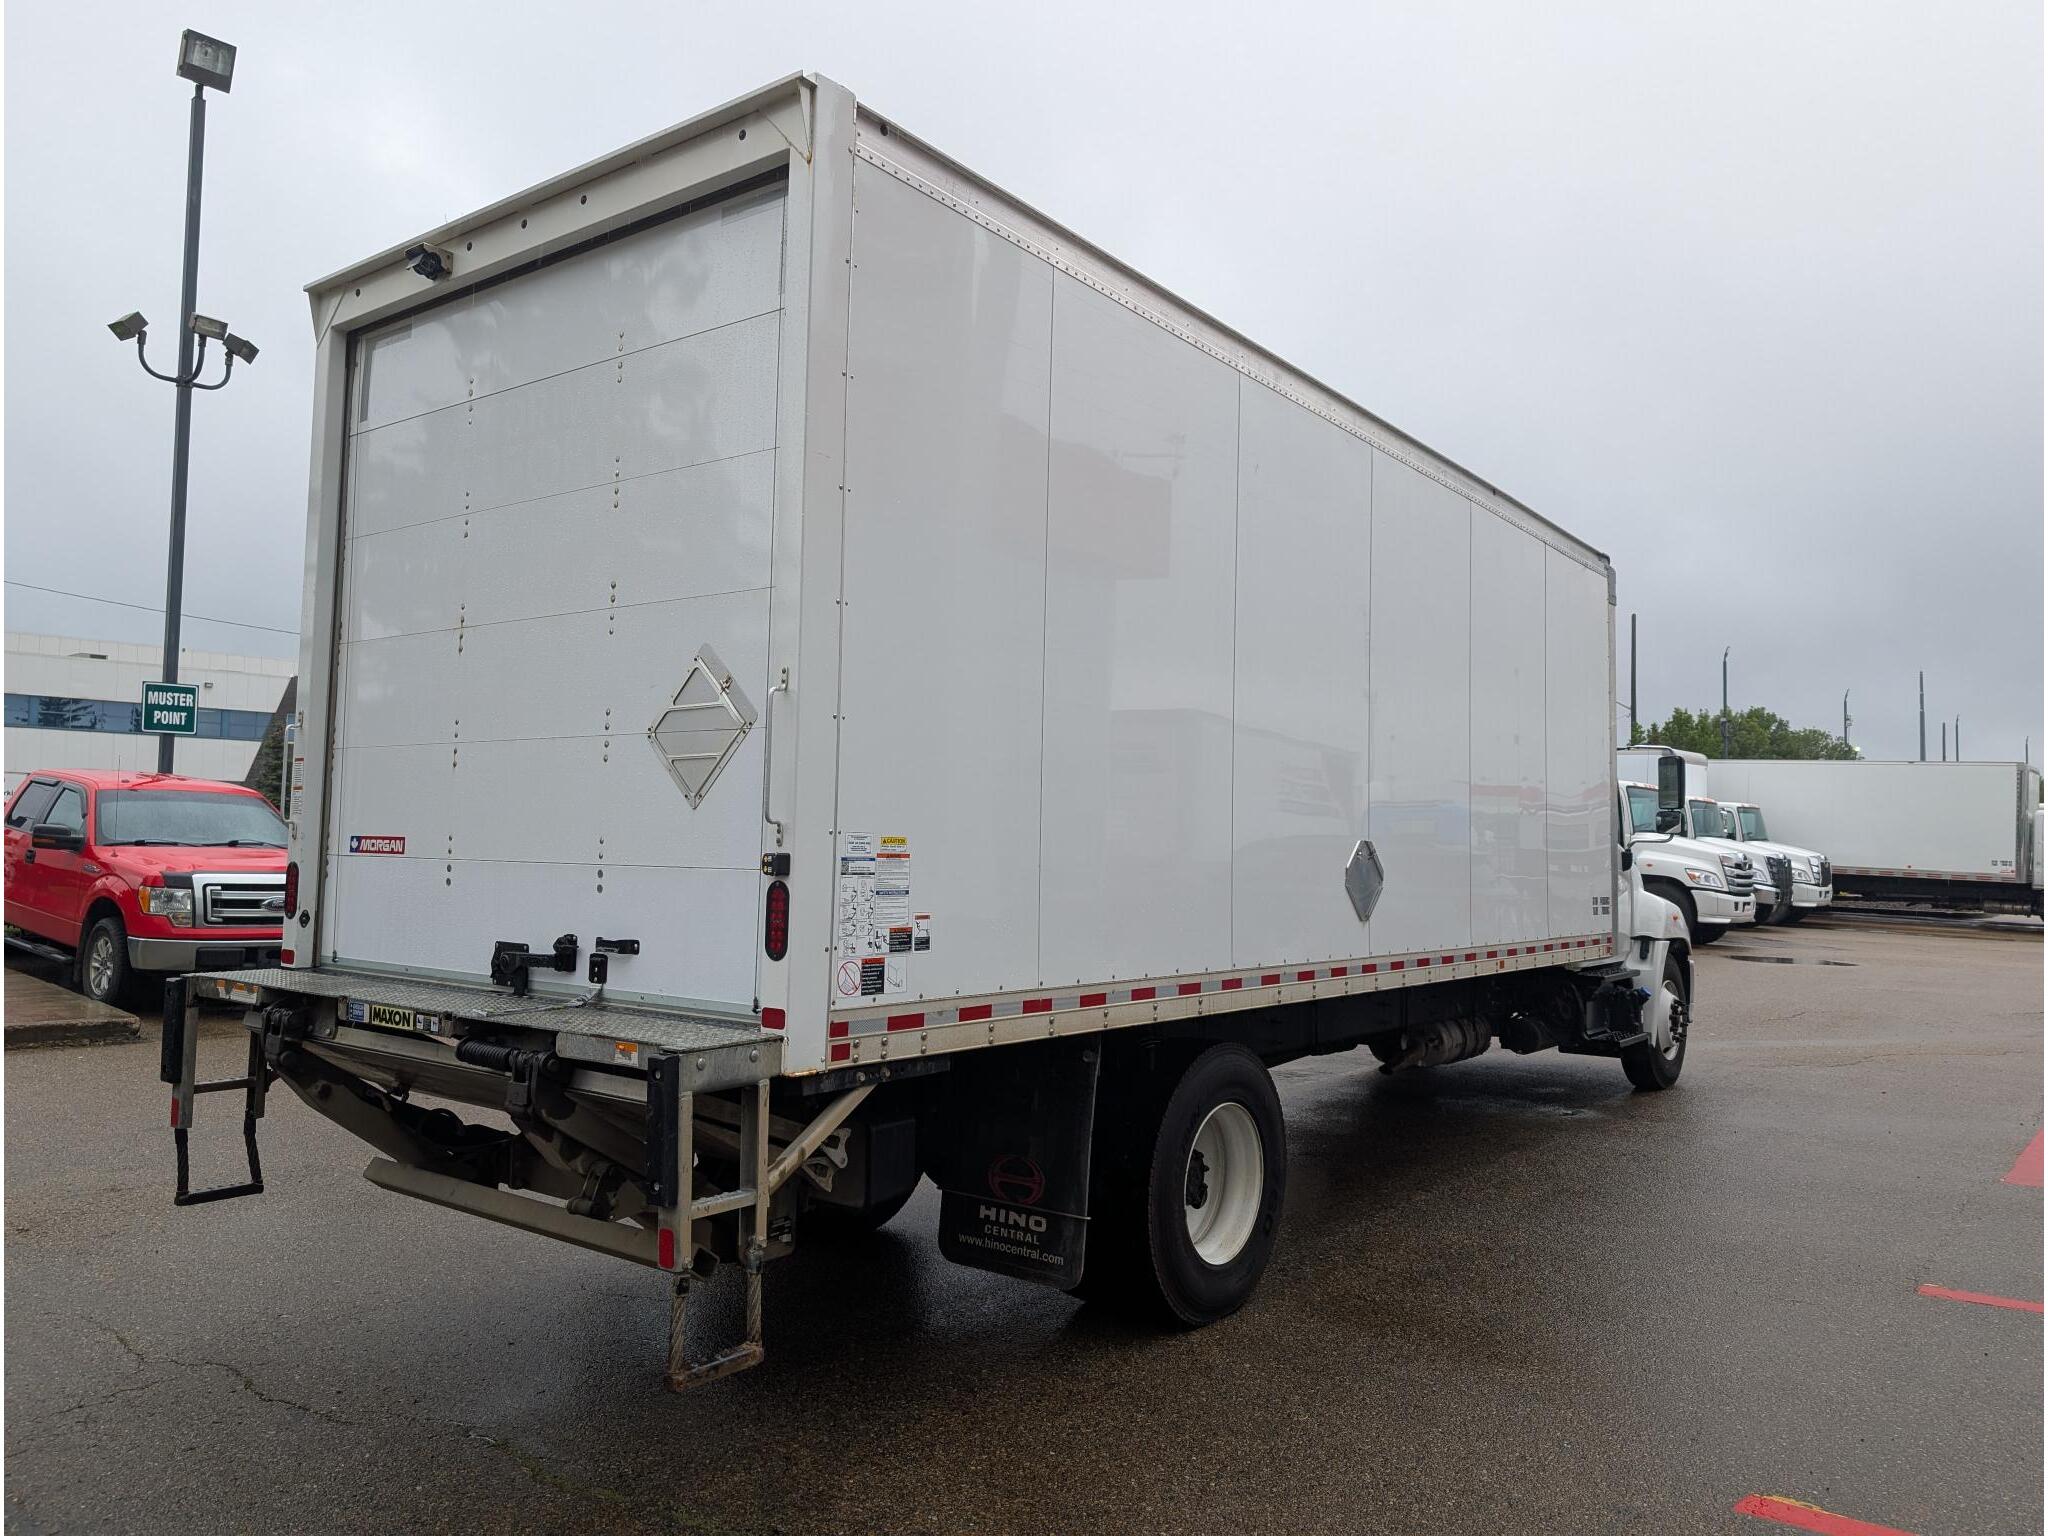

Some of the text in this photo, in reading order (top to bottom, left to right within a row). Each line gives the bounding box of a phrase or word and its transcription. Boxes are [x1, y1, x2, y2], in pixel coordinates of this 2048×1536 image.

[147, 691, 194, 707] MUSTER
[153, 710, 188, 725] POINT
[359, 839, 404, 852] MORGAN
[373, 1007, 411, 1027] MAXON
[979, 1205, 1047, 1232] HINO
[984, 1224, 1040, 1245] CENTRAL
[958, 1233, 1064, 1265] www.hinocentral.com
